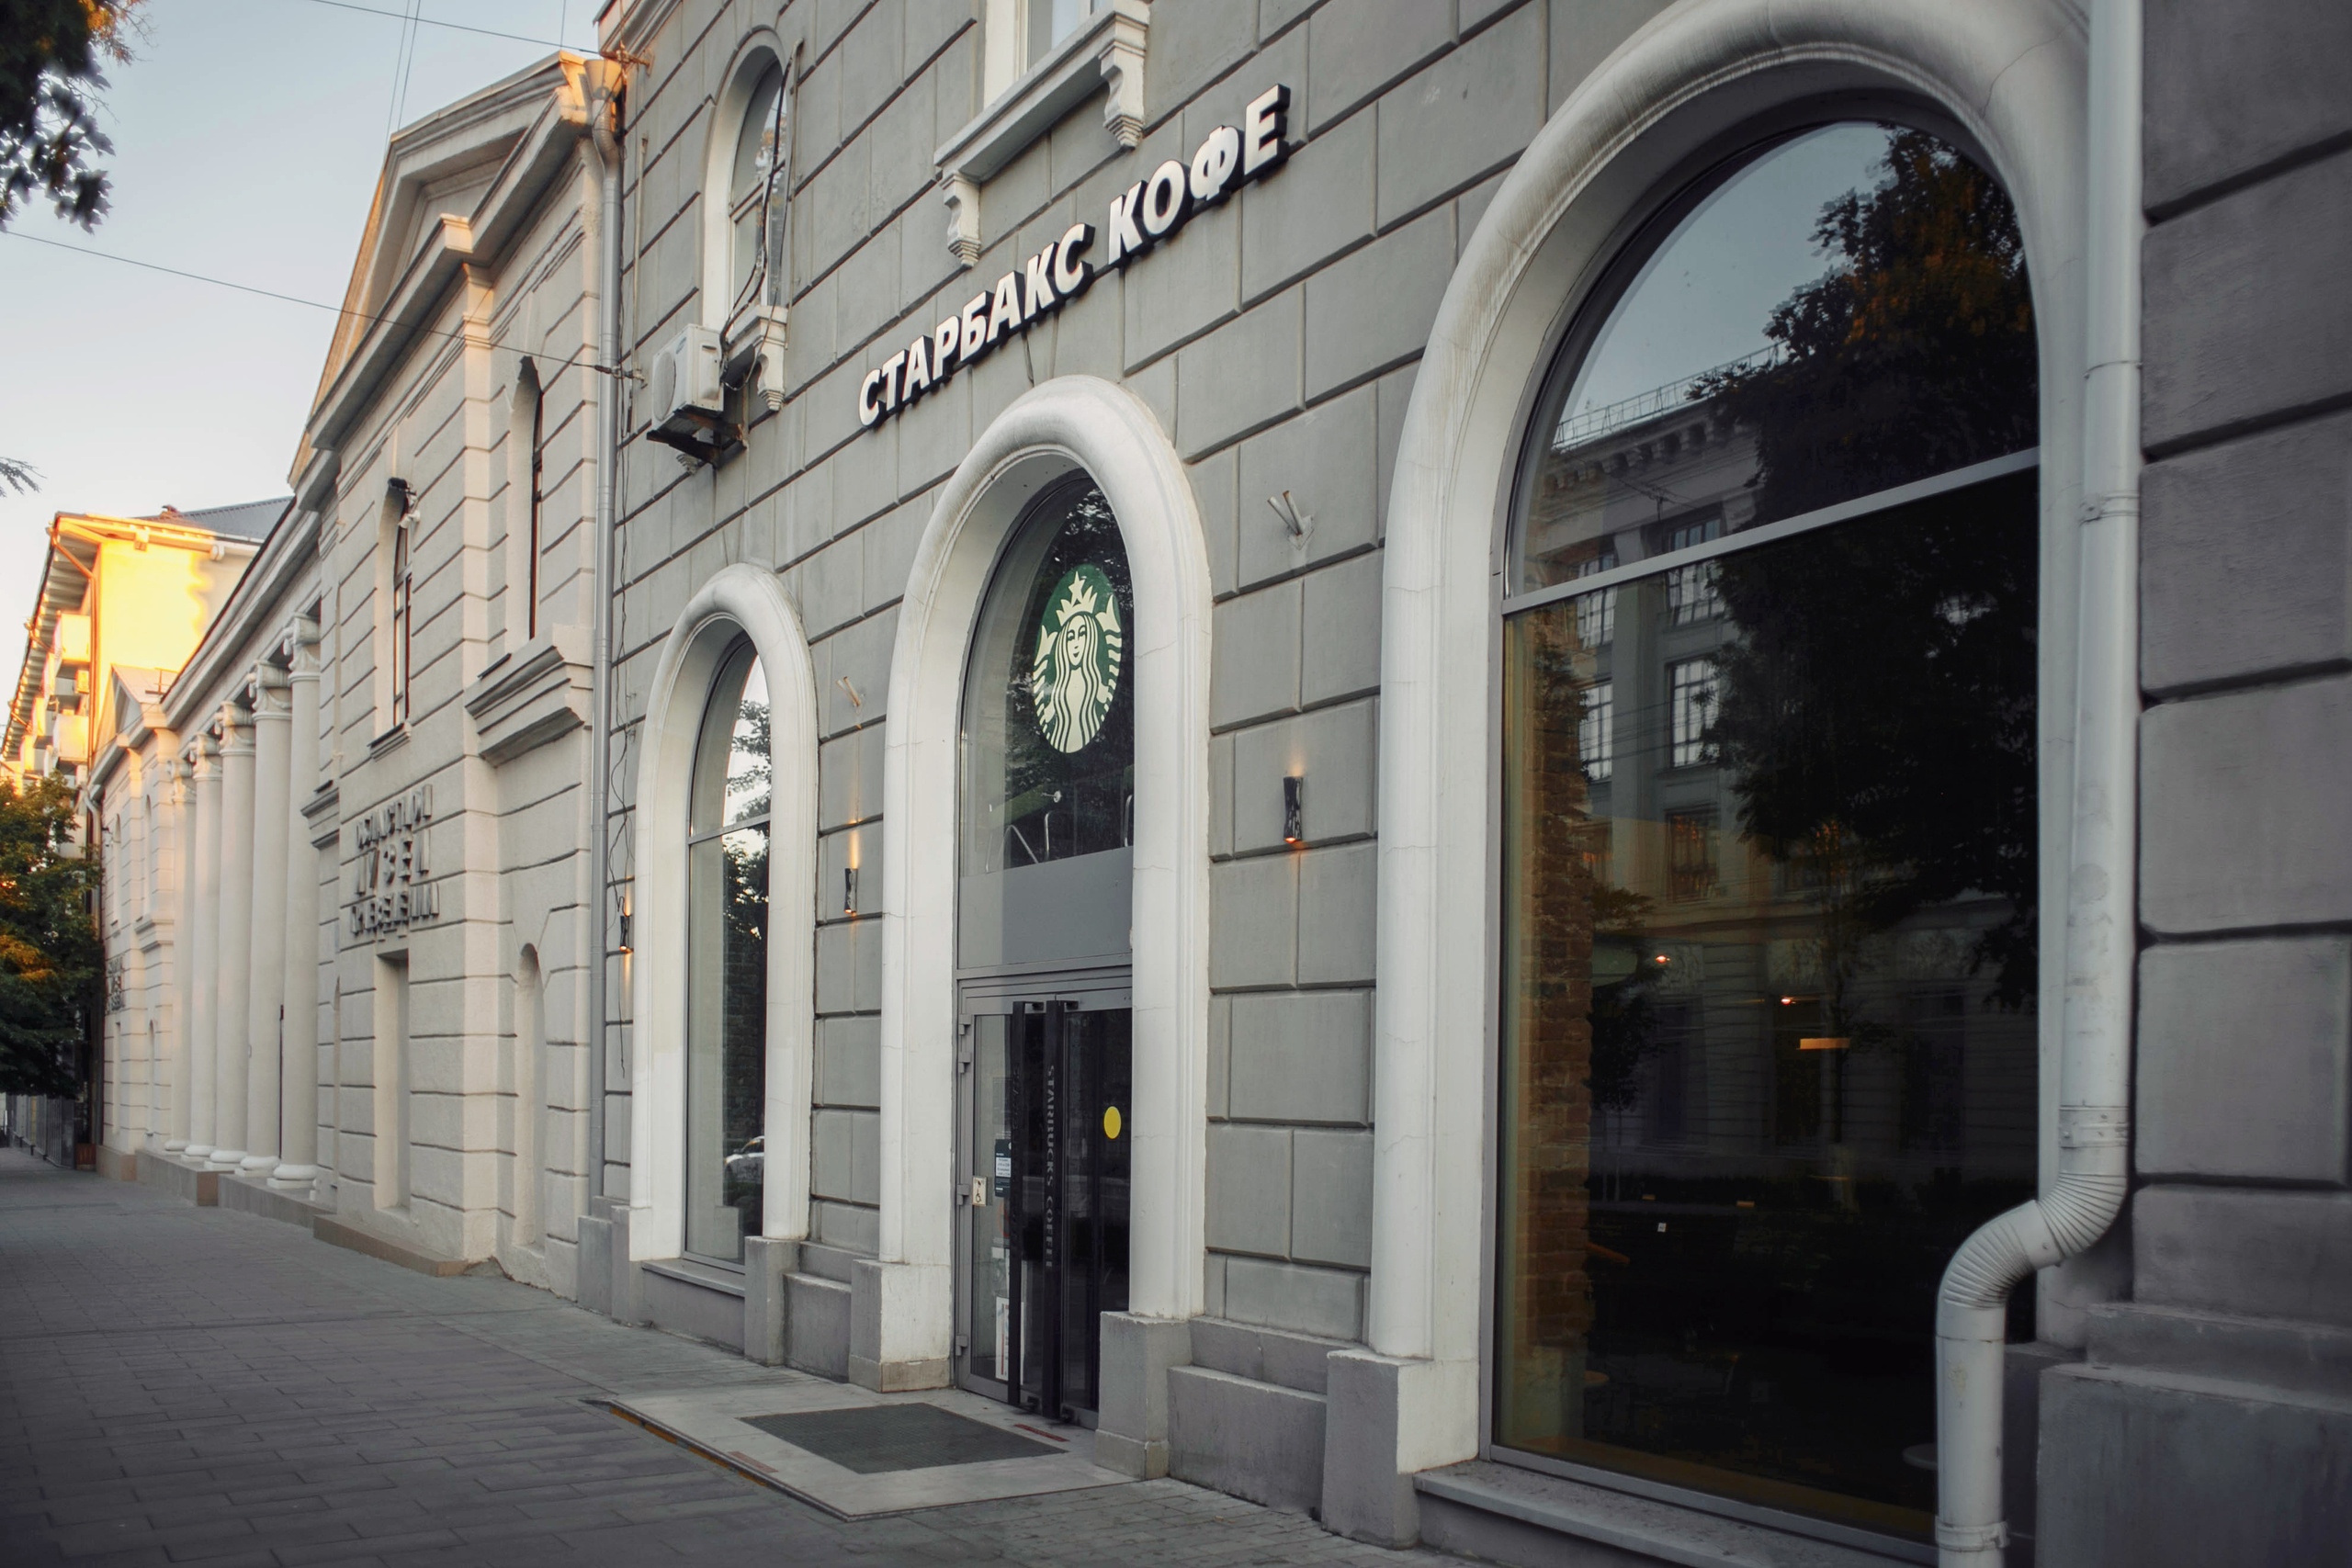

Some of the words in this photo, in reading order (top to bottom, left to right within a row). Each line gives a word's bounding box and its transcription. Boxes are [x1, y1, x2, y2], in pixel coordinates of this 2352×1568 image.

[859, 222, 1094, 428] СТАРБАКС
[1108, 83, 1291, 269] КОФЕ
[1046, 1064, 1056, 1187] STARBUCKS
[1046, 1195, 1055, 1269] COFFEE
